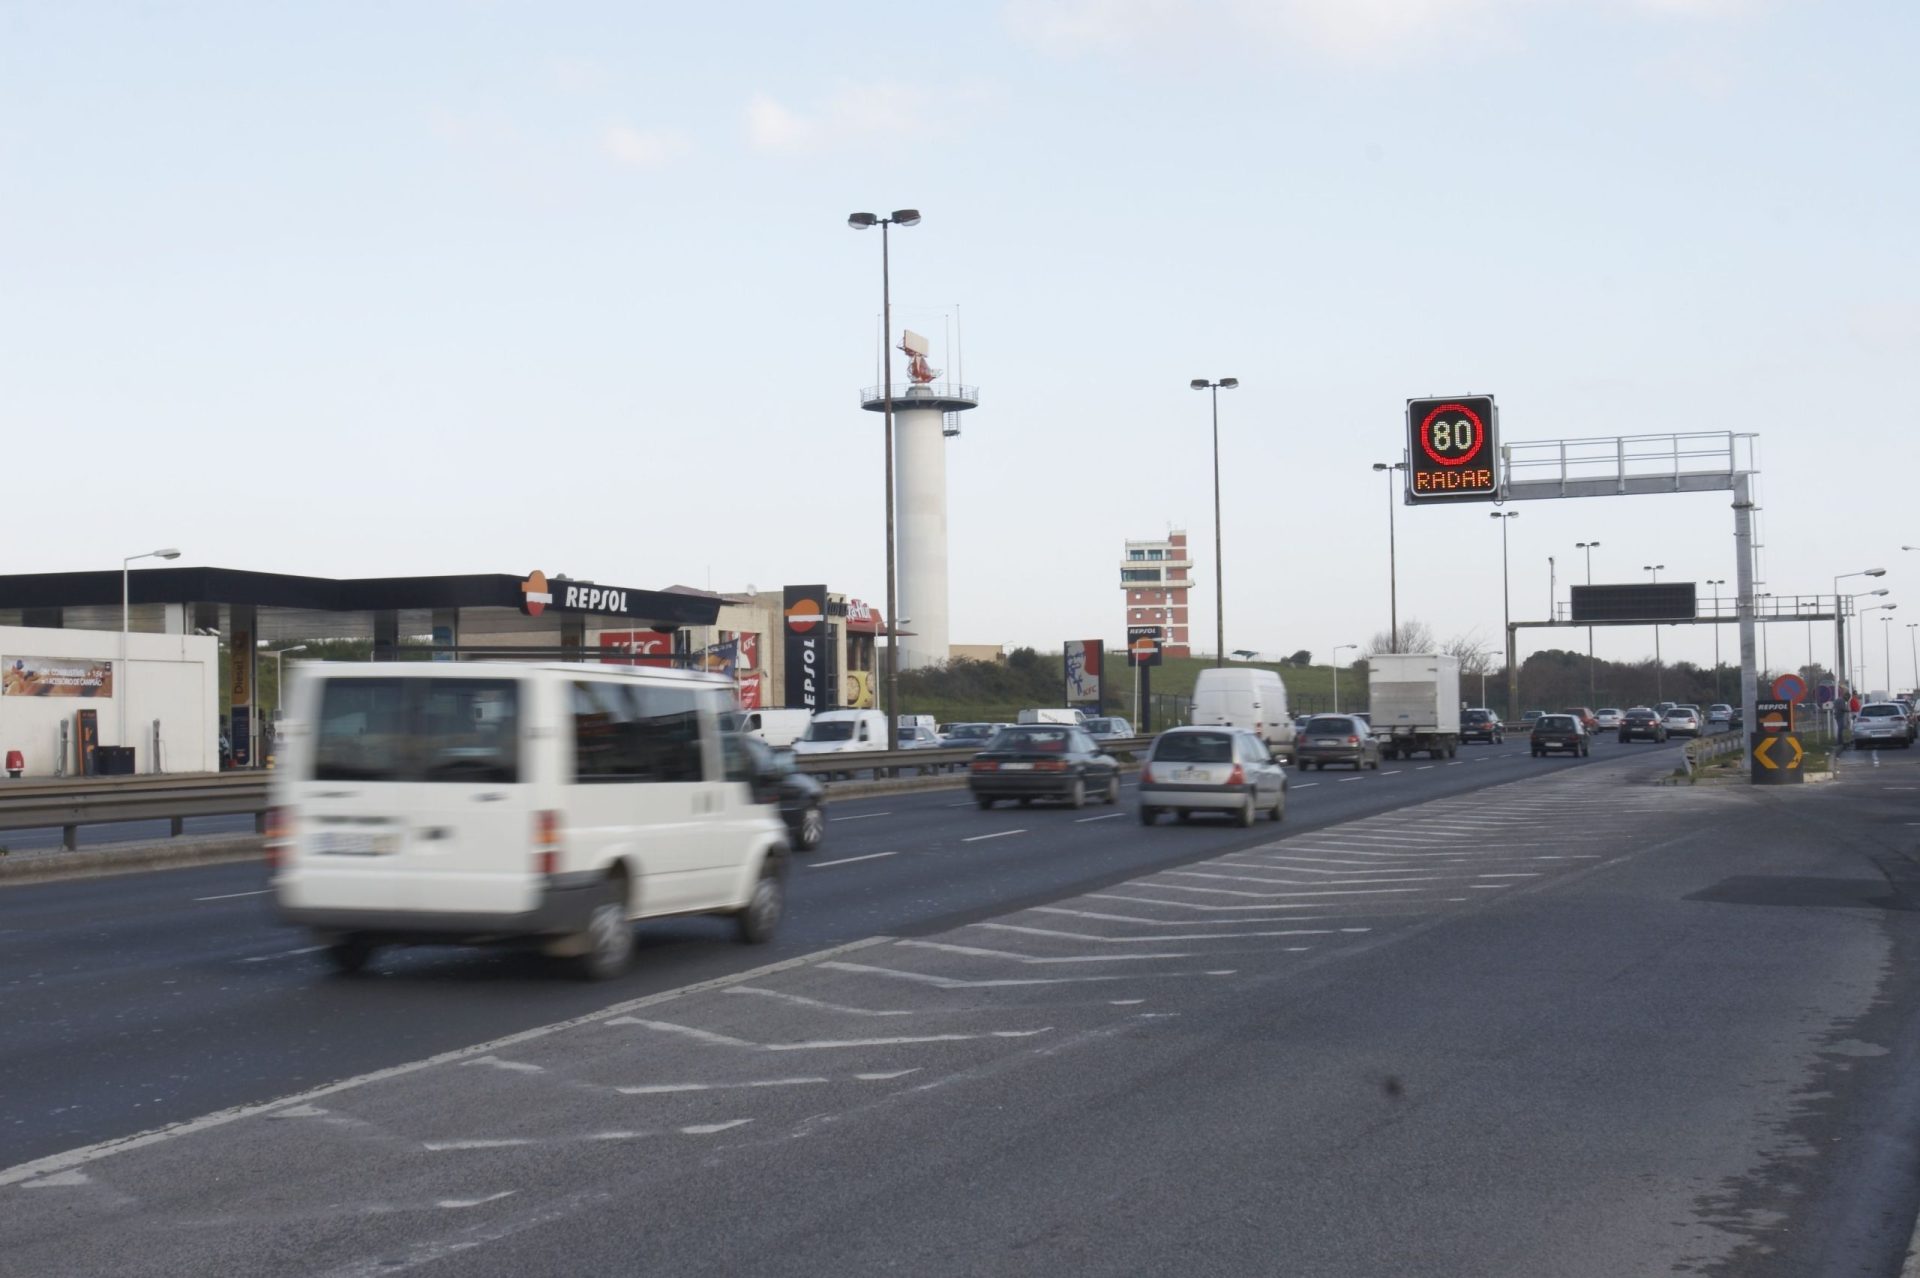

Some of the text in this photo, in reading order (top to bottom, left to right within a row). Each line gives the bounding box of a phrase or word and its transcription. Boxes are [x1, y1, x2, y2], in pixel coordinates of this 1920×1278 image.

[1433, 420, 1472, 450] 80
[1417, 469, 1491, 489] RADAR
[565, 586, 628, 613] REPSOL
[743, 634, 756, 652] KFC
[1083, 685, 1097, 697] KFC
